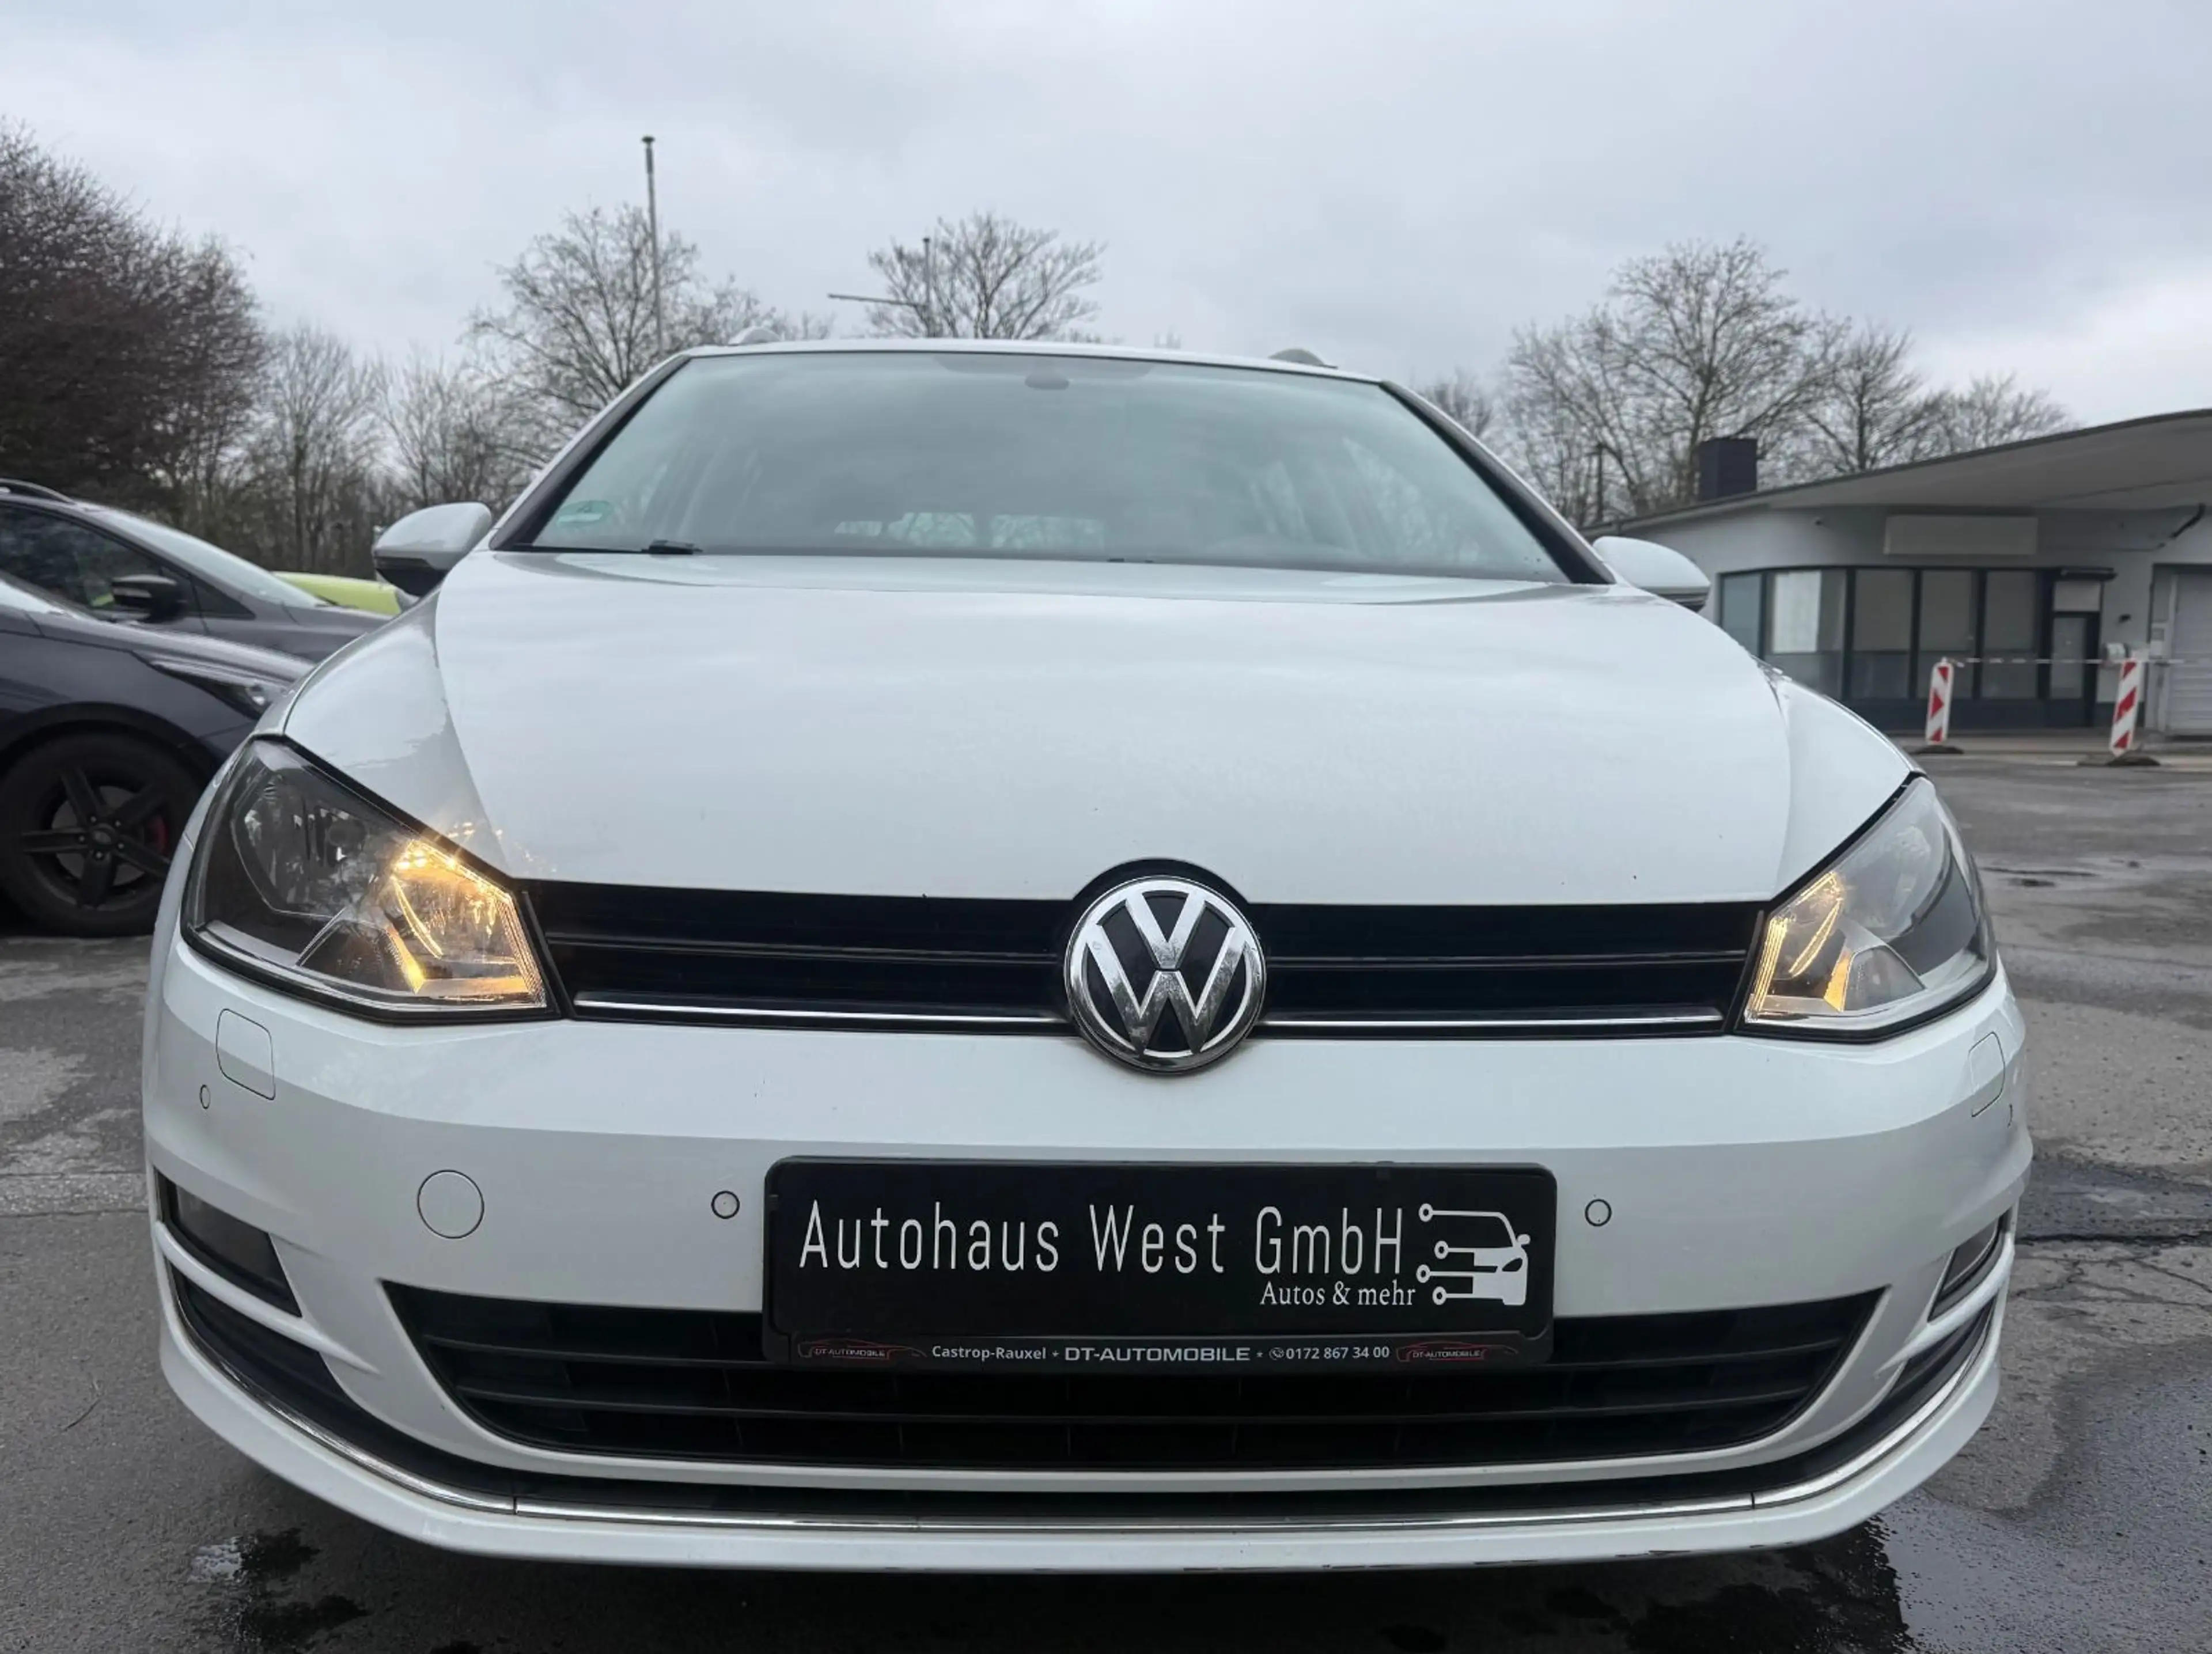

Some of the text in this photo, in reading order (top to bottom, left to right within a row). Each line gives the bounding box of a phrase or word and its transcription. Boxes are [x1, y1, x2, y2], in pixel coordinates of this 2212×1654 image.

[1076, 881, 1257, 1064] VW
[800, 1199, 1403, 1274] Autohaus West GmbH
[1260, 1280, 1416, 1306] Autos & mehr
[931, 1345, 1390, 1362] Castrop-Rauxel DT-AUTOMOBILE 0172 867 34 00
